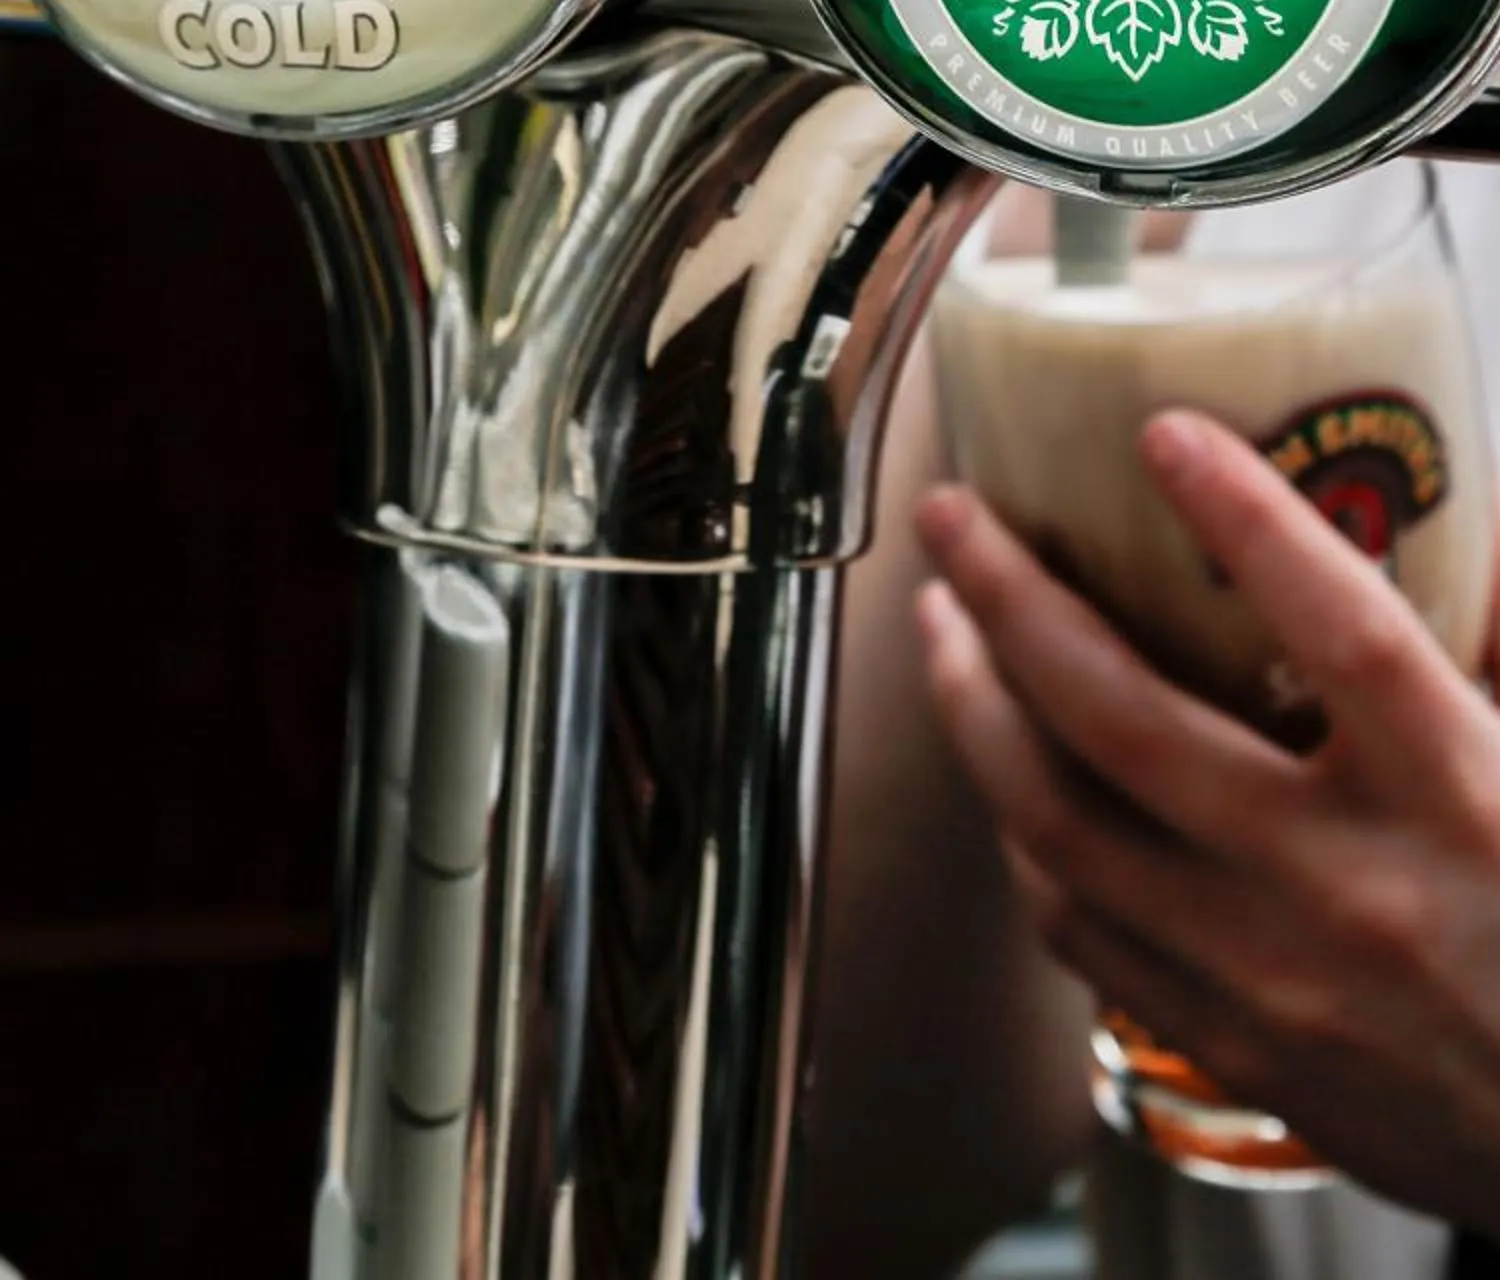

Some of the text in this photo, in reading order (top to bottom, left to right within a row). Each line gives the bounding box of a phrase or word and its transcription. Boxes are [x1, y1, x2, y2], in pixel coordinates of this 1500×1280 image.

[929, 33, 1351, 158] PREMIUM QUALITY BEER
